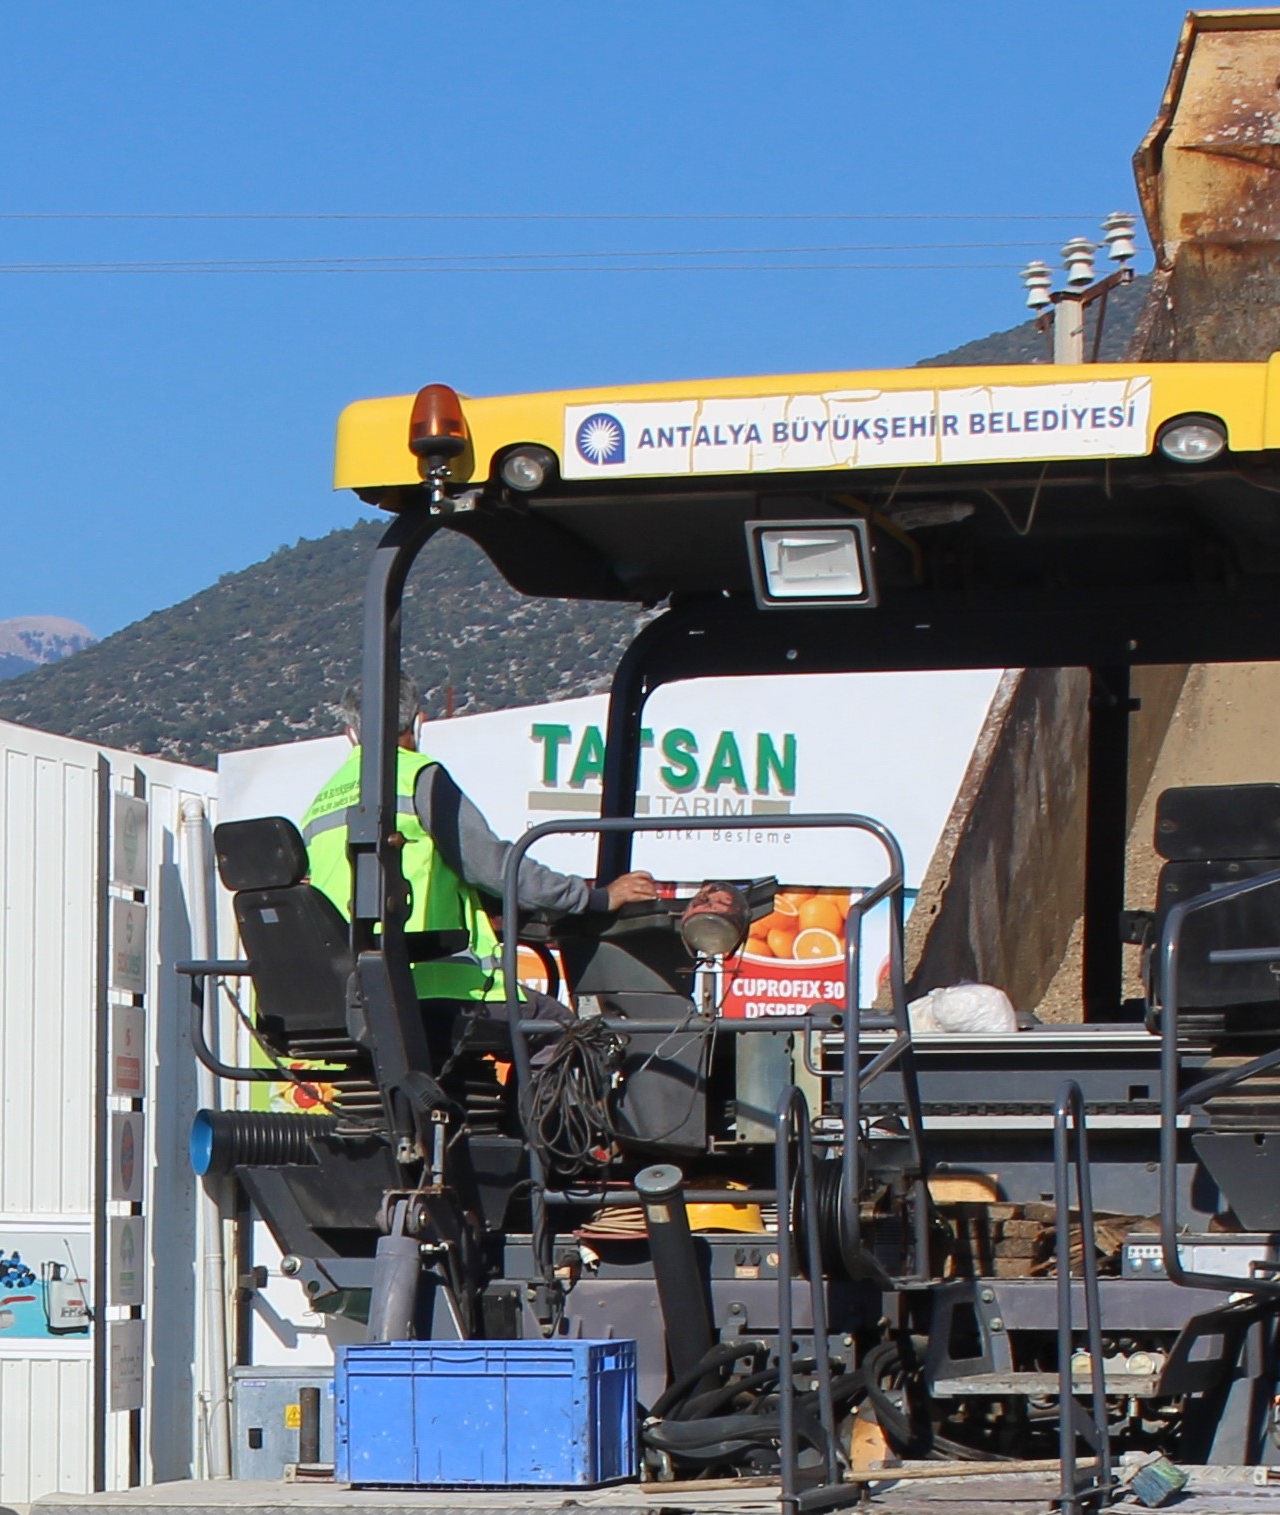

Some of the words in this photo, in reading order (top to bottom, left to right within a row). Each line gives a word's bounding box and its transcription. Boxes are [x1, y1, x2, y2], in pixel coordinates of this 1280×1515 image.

[637, 423, 762, 449] ANTALYA
[772, 410, 959, 445] BÜYÜKŞEHİR
[969, 400, 1136, 435] BELEDİYESİ
[656, 795, 745, 816] TARIM
[712, 829, 792, 844] Besleme
[732, 978, 821, 998] CUPROFIX
[823, 981, 845, 999] 30
